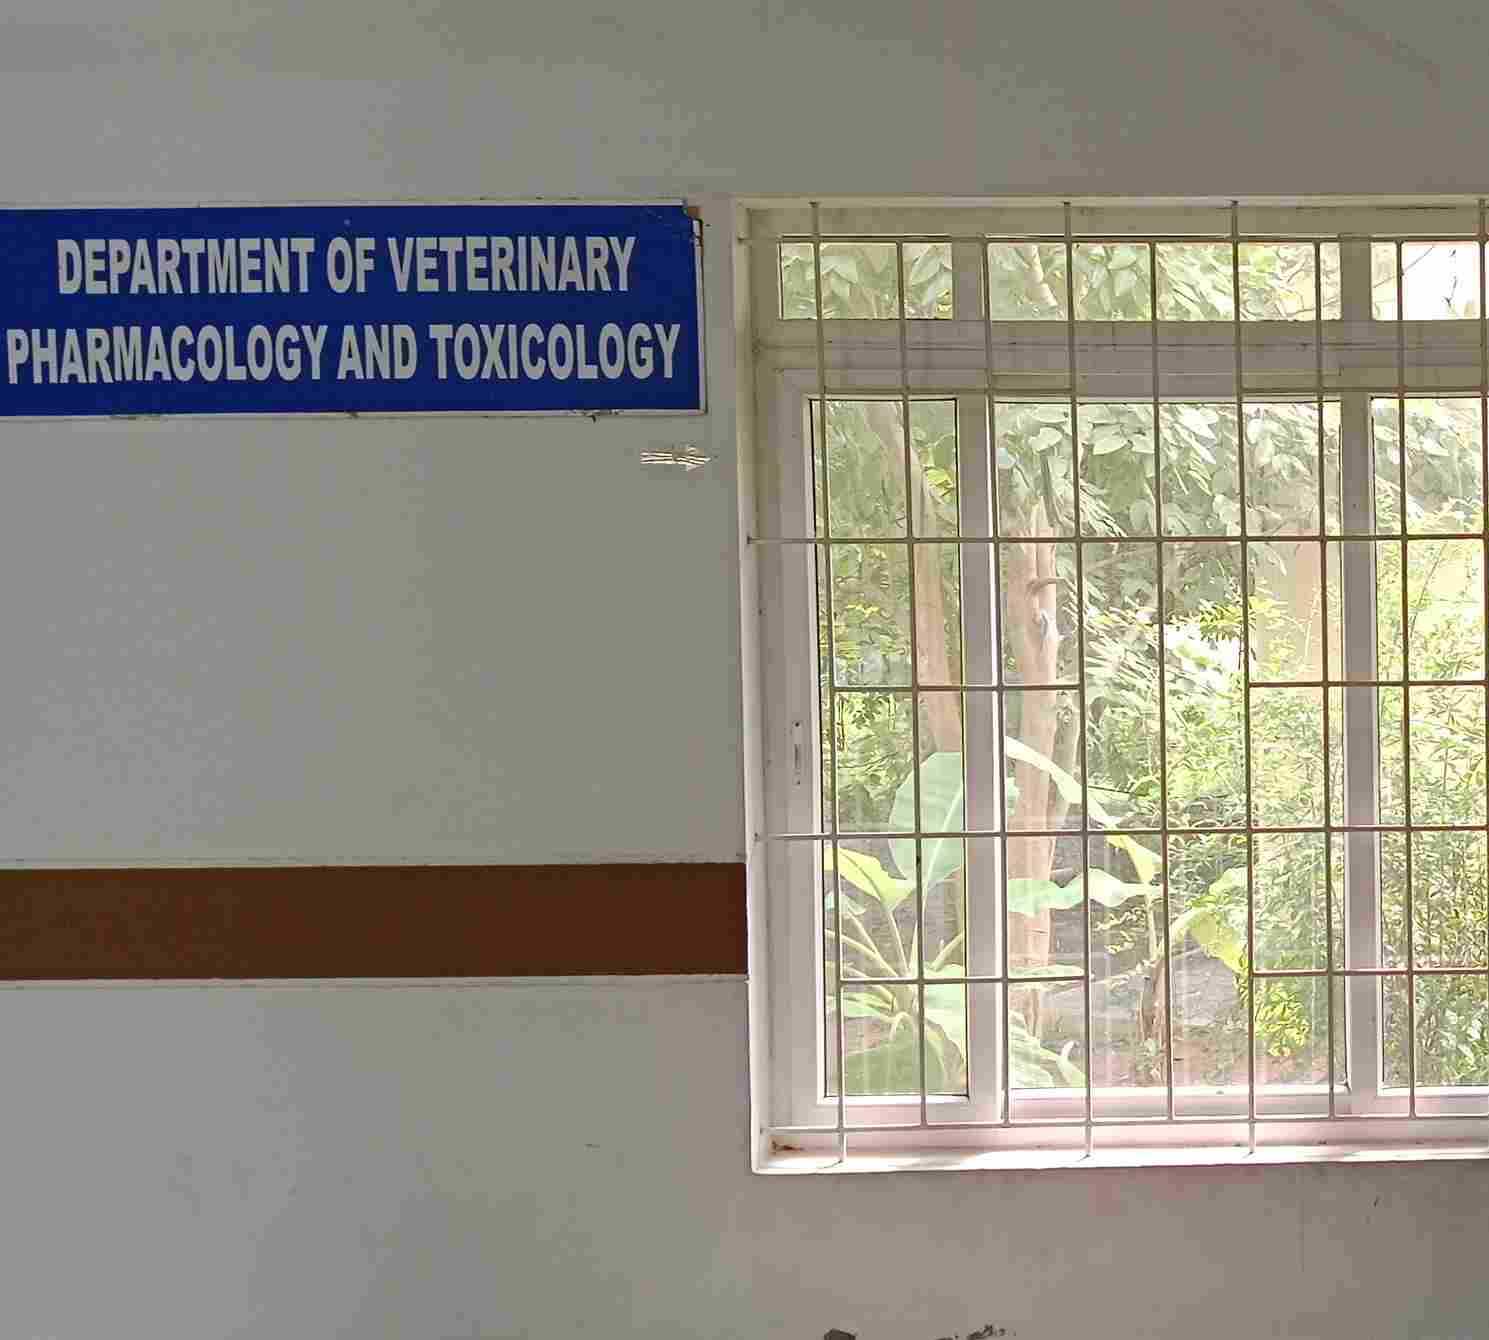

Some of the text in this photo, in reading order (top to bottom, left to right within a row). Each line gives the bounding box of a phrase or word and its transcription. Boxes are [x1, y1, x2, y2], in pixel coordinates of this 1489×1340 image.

[57, 235, 636, 295] DEPARTMENT OF VETERINARY
[6, 322, 681, 385] PHARMACOLOGY AND TOXICOLOGY
